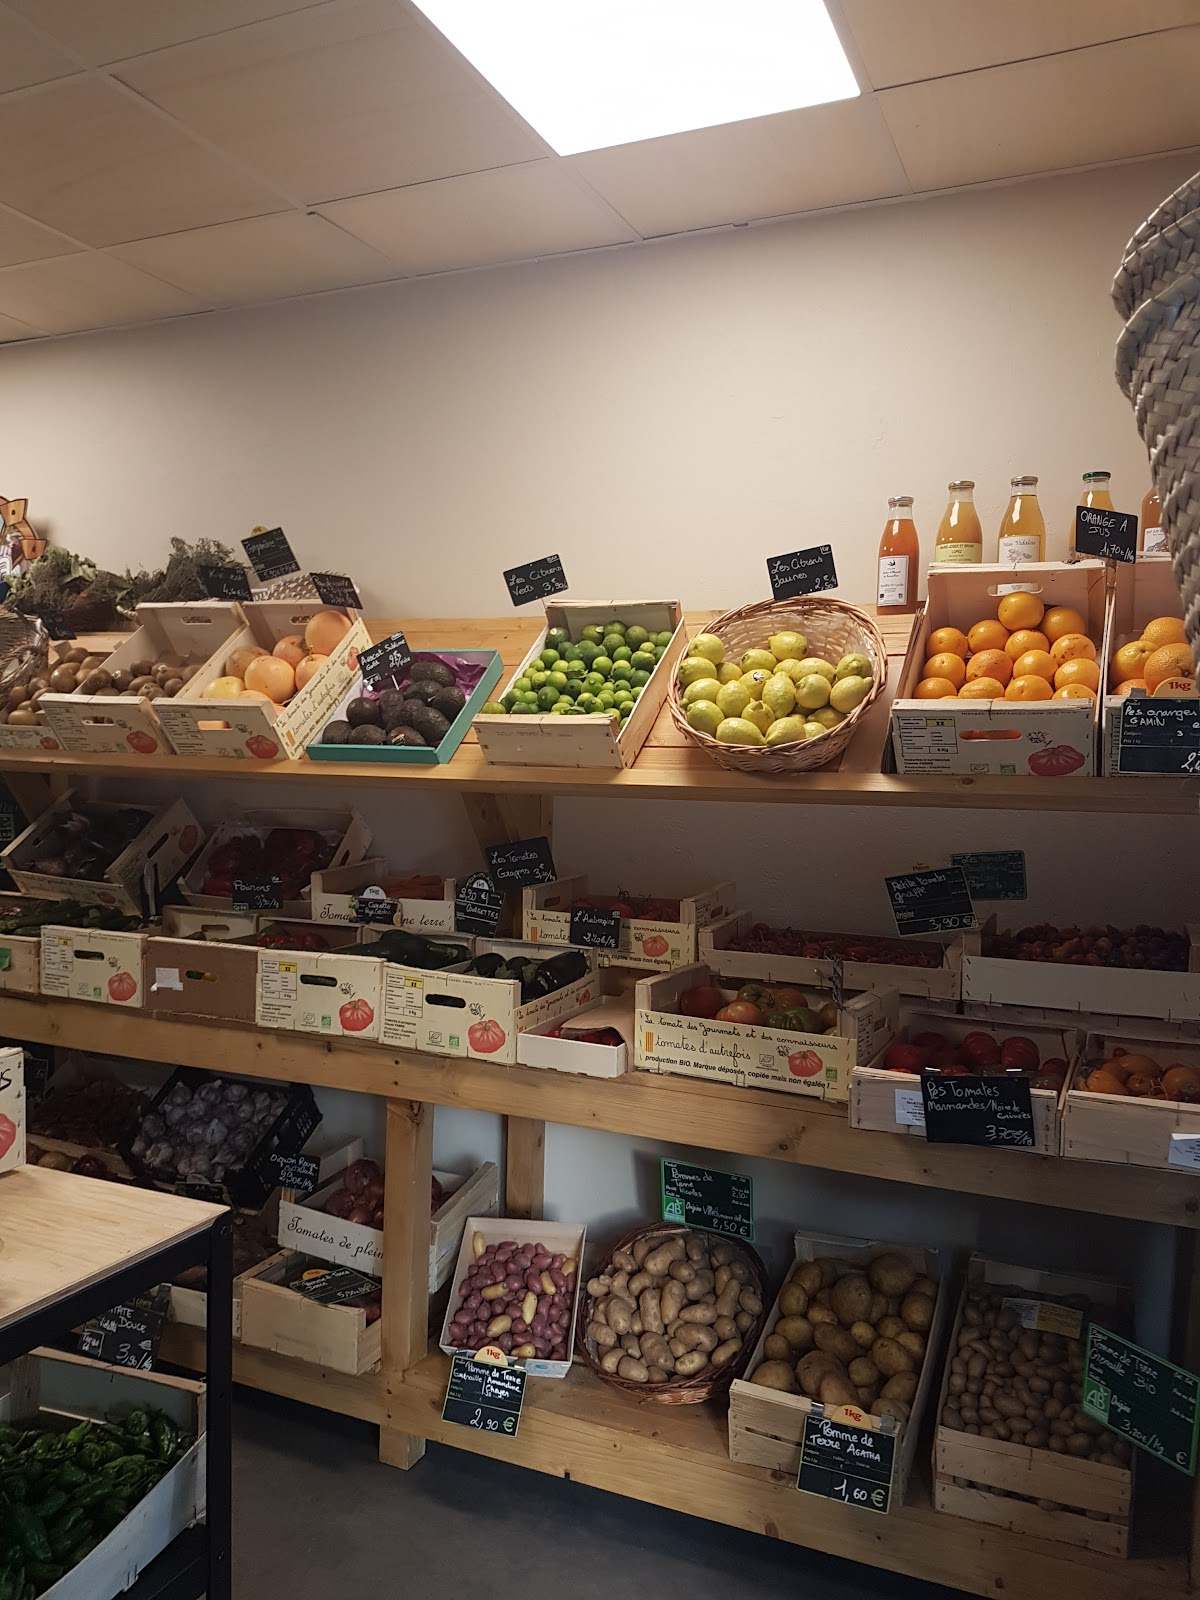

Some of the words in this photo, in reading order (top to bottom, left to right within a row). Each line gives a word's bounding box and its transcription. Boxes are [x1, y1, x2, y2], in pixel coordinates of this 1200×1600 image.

[1080, 511, 1116, 528] ORANGE
[1119, 517, 1128, 533] A
[1088, 526, 1111, 537] JUS
[771, 561, 790, 574] Les
[655, 1034, 696, 1053] tomates
[658, 1016, 684, 1029] tomate
[745, 1029, 757, 1039] et
[775, 1037, 838, 1051] connaisseurs
[645, 1055, 678, 1066] production
[693, 1062, 717, 1073] Marque
[771, 1074, 788, 1084] mais
[788, 1078, 802, 1086] non
[943, 1080, 1000, 1099] Tomates
[712, 1218, 738, 1232] 2,50
[287, 1215, 334, 1244] Tomates
[338, 1235, 353, 1250] de
[351, 1240, 384, 1260] plein
[469, 1407, 501, 1432] 2,90
[502, 1416, 517, 1433] €
[843, 1407, 862, 1422] 1kg
[818, 1420, 859, 1444] Pomme
[859, 1432, 875, 1449] de
[836, 1443, 881, 1463] AGATHA
[870, 1488, 886, 1508] €
